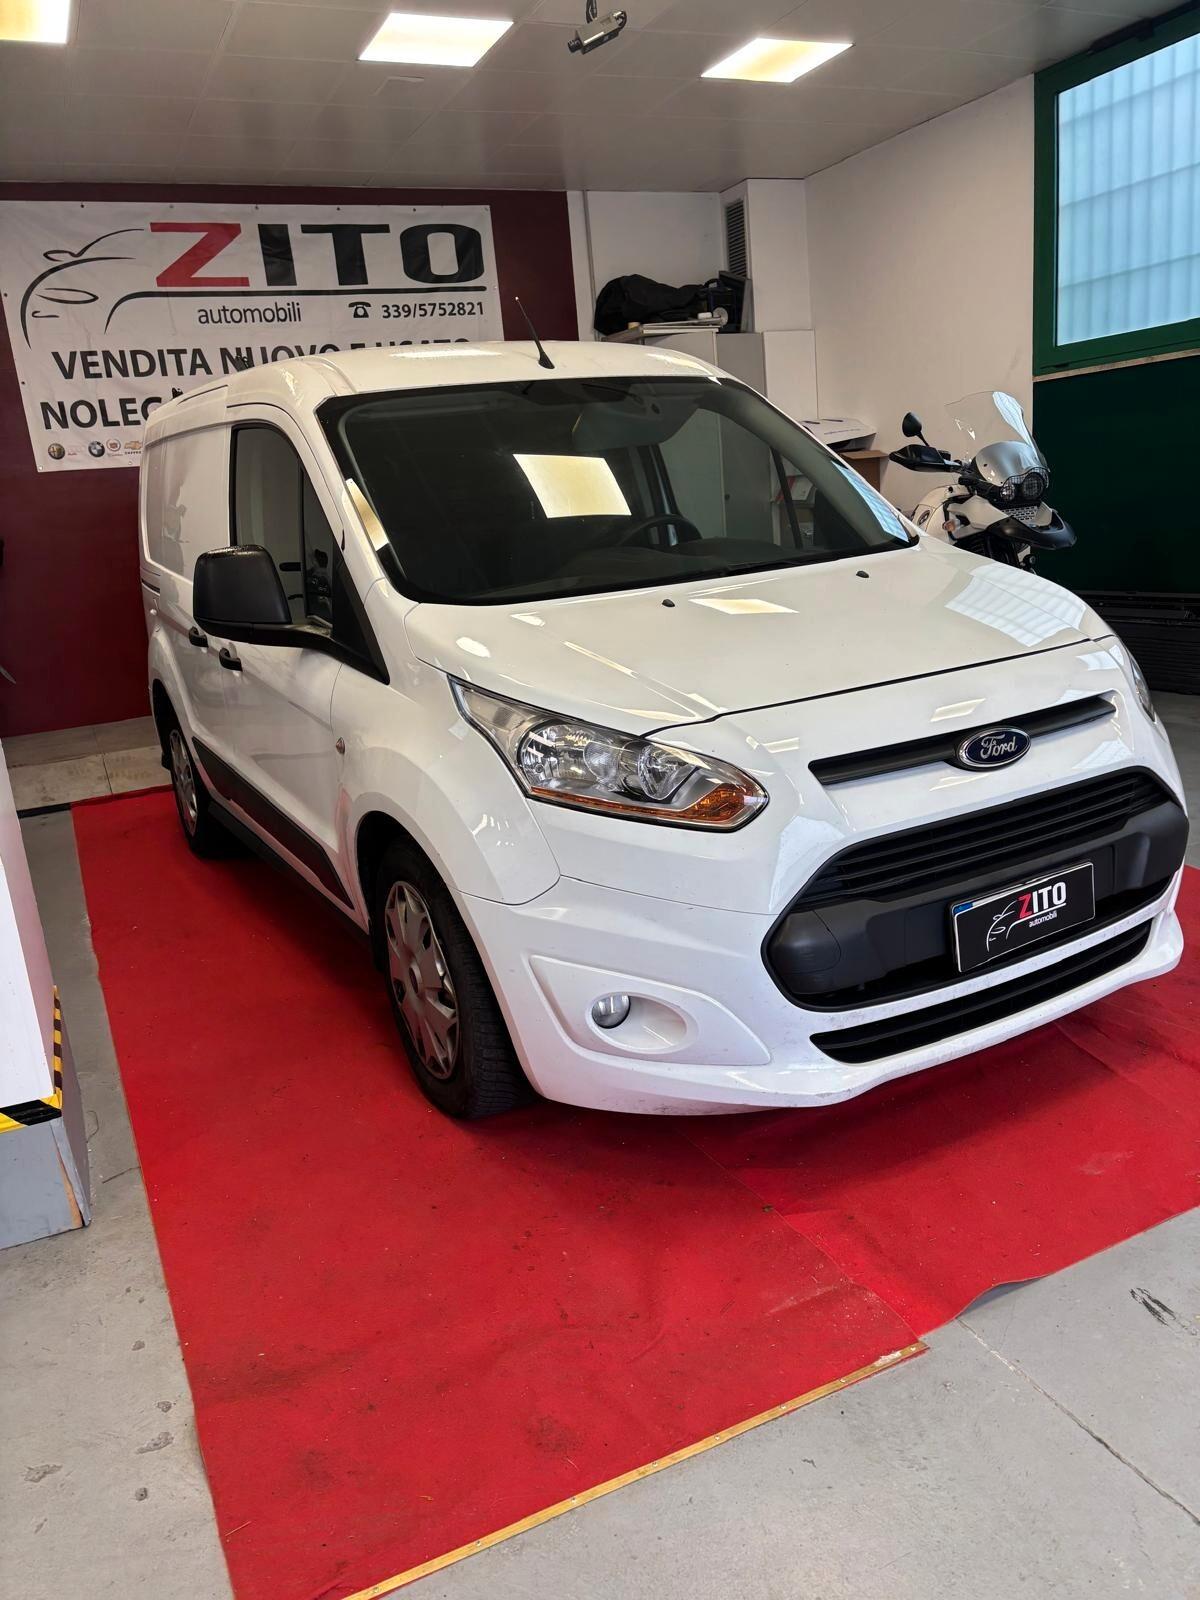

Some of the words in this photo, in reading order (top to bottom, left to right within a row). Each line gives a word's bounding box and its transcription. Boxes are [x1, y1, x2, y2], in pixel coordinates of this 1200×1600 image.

[150, 222, 485, 287] ZITO
[197, 302, 302, 324] automobili
[381, 301, 485, 318] 339/5752821
[51, 348, 213, 380] VENDITA
[980, 733, 1018, 760] Ford
[1017, 881, 1068, 919] ZITO
[1028, 910, 1058, 928] automobili
